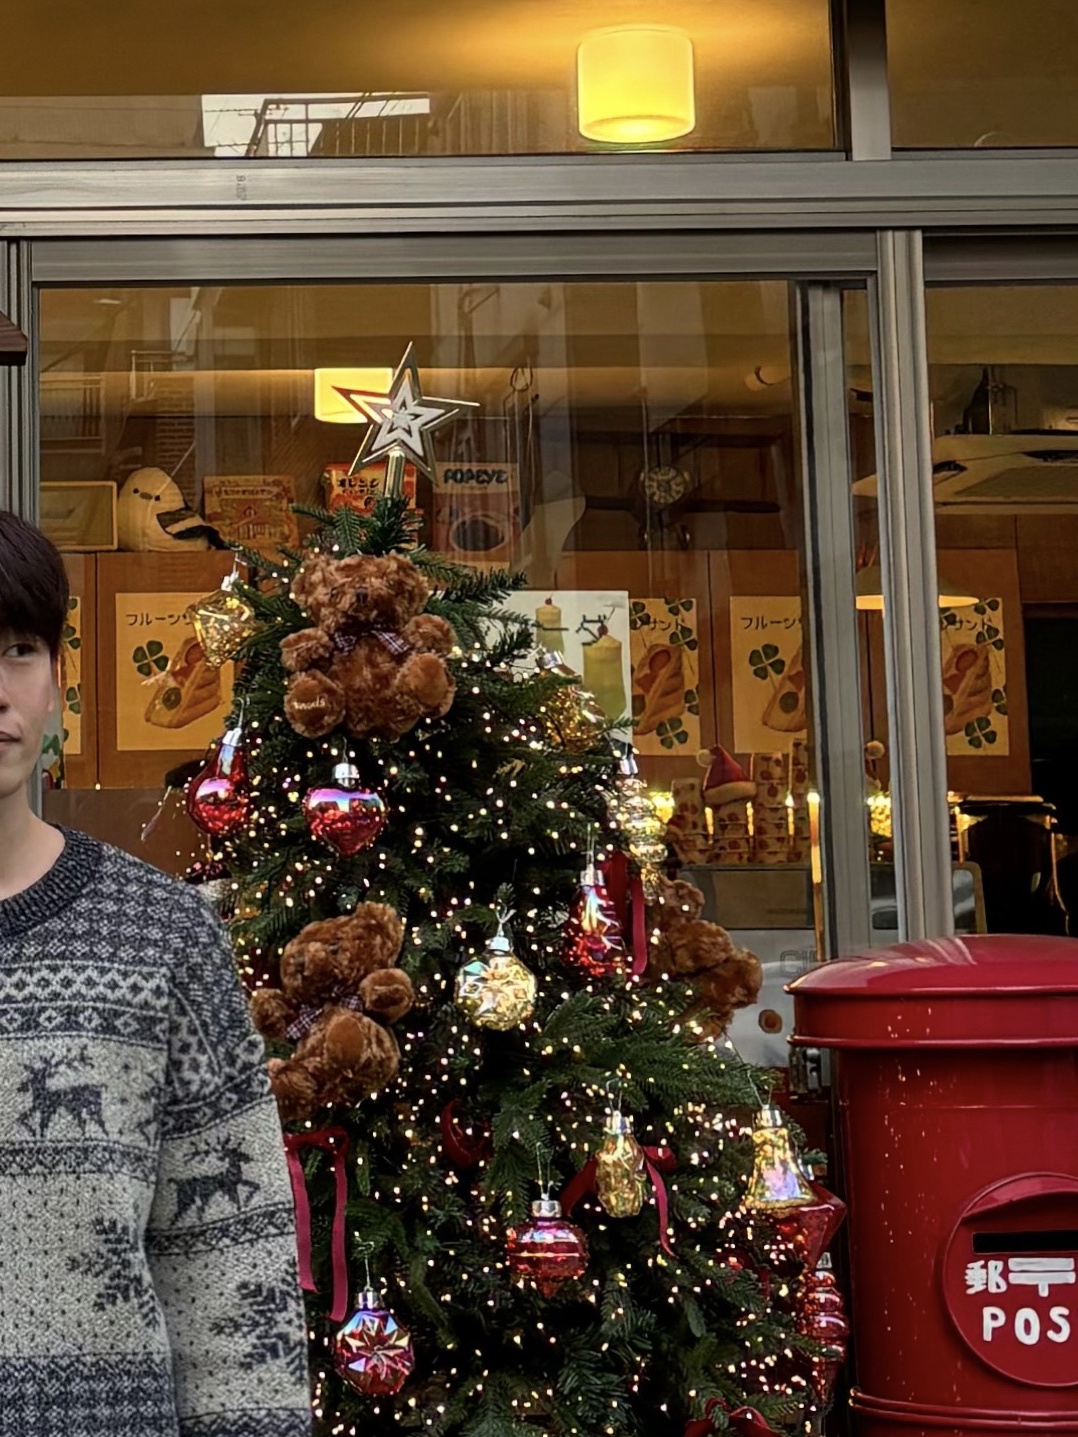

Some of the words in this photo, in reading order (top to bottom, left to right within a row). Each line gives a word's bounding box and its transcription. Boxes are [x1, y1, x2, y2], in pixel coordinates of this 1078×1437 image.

[444, 468, 508, 485] POPEYE
[740, 614, 801, 630] フルーツ
[983, 1306, 1070, 1345] POS
